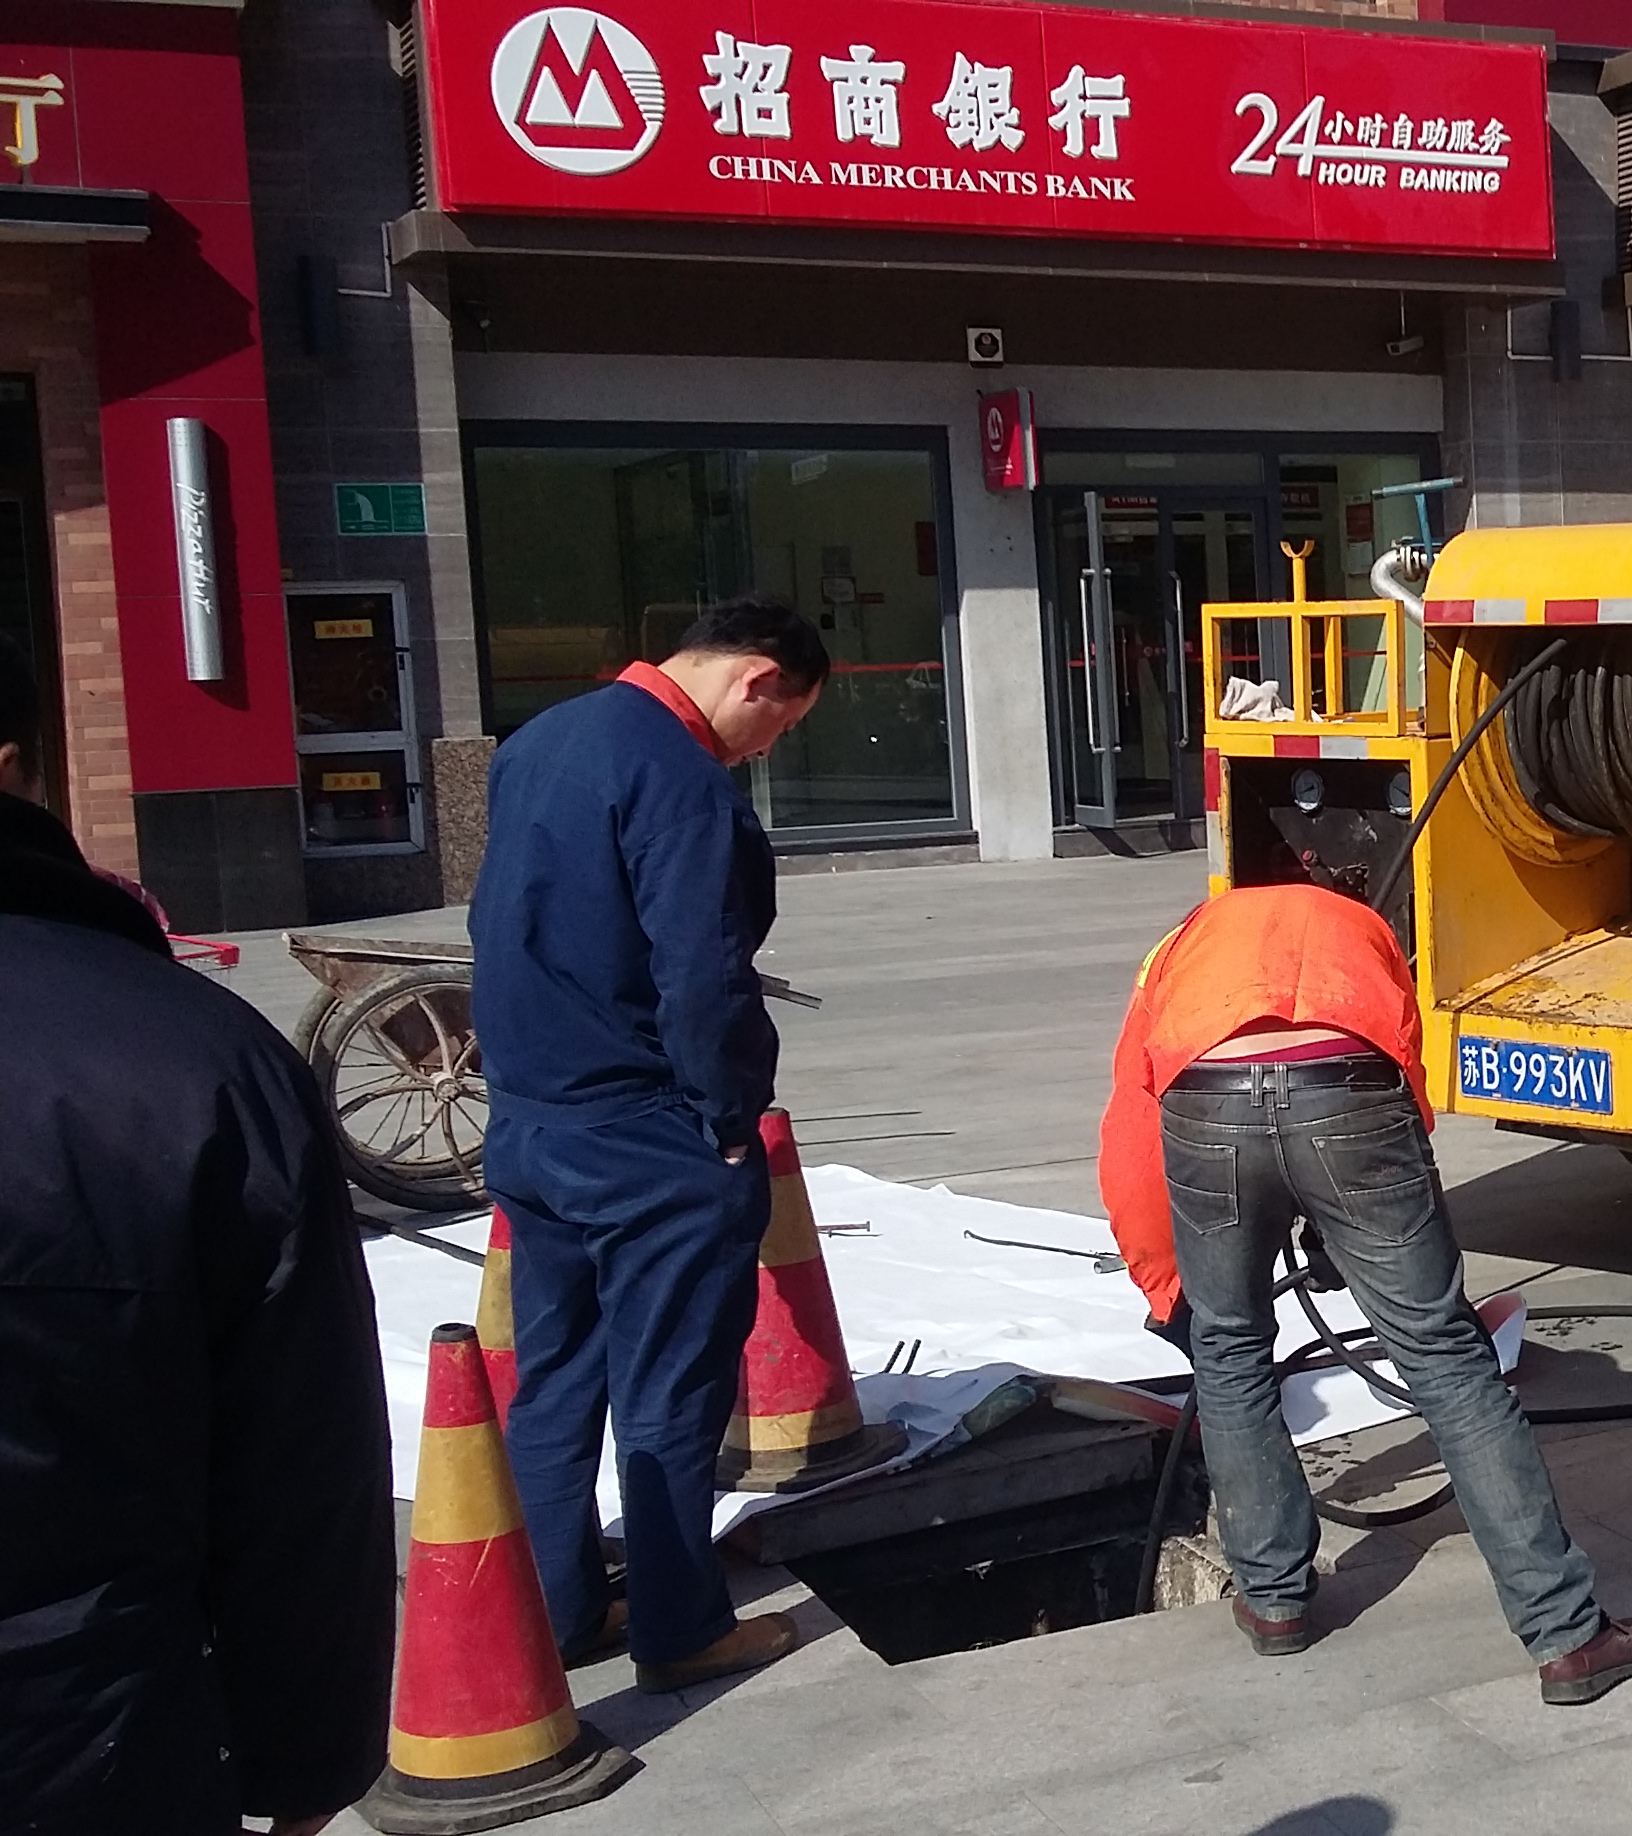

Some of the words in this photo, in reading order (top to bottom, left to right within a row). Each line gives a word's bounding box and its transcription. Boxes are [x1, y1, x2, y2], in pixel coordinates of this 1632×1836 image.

[1230, 92, 1326, 176] 24
[1323, 111, 1511, 155] 小时自助服务
[708, 155, 823, 185] CHINA
[831, 162, 1038, 196] MERCHANTS
[1045, 174, 1136, 201] BANK
[1318, 162, 1387, 187] HOUR
[1399, 168, 1501, 193] BANKING
